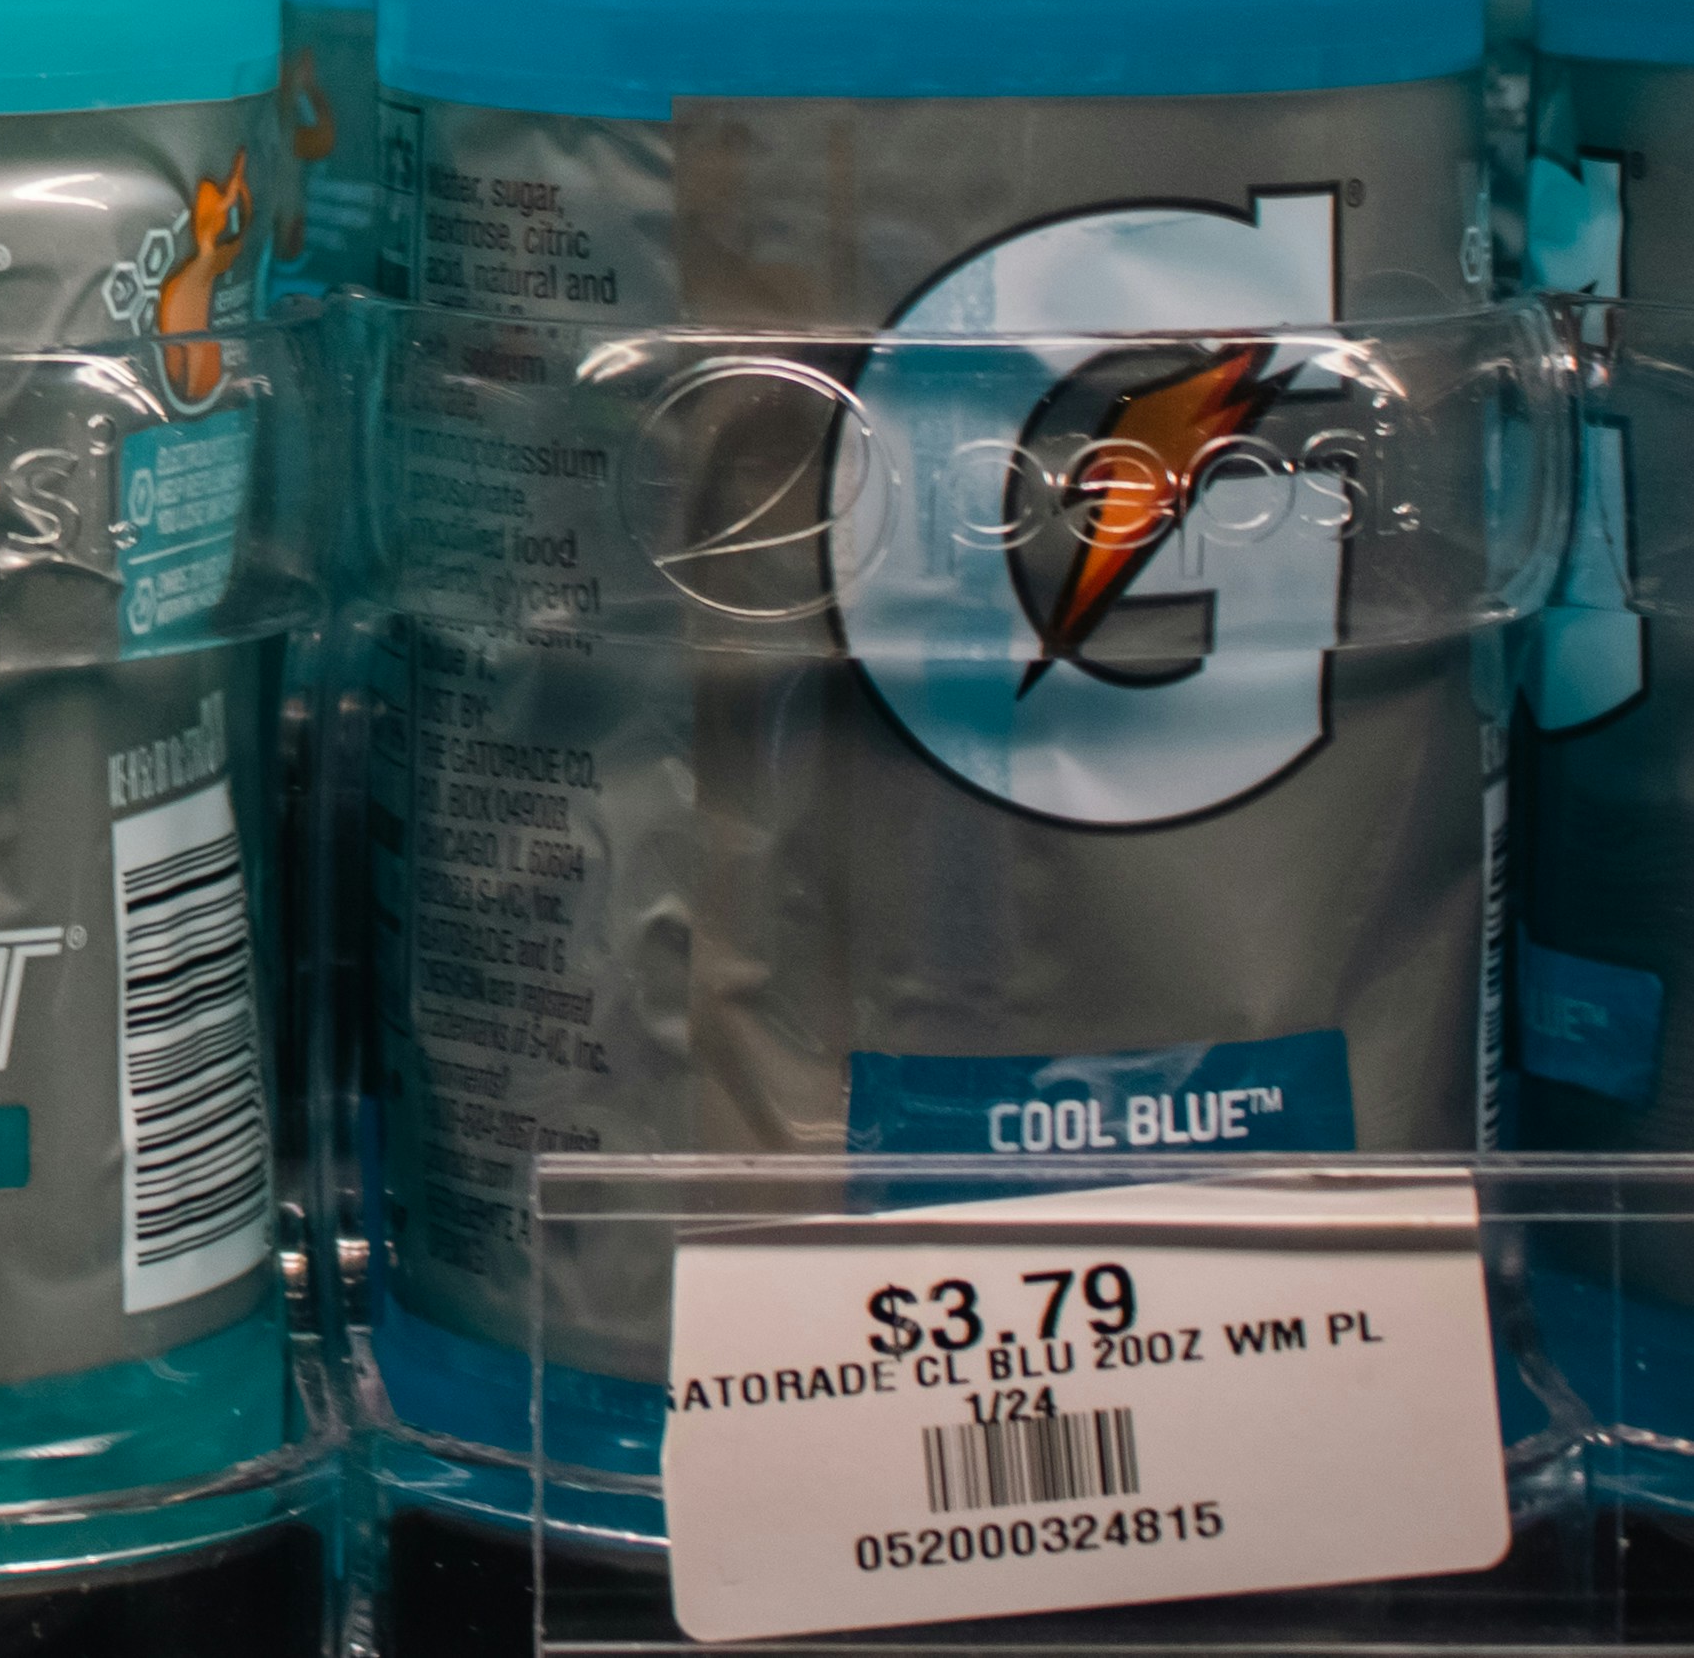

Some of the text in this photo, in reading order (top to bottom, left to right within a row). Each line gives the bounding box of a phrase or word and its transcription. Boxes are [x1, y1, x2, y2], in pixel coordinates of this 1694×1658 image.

[491, 174, 566, 219] sugar,
[523, 216, 592, 261] citric
[566, 267, 619, 306] and
[988, 1099, 1127, 1154] COOL
[866, 1261, 1140, 1361] $3.79
[915, 1353, 972, 1388] CL
[990, 1338, 1076, 1382] BLU
[1225, 1318, 1308, 1358] WM
[1327, 1310, 1386, 1345] PL
[965, 1385, 1058, 1426] 1/24
[855, 1500, 1226, 1574] 052000324815
